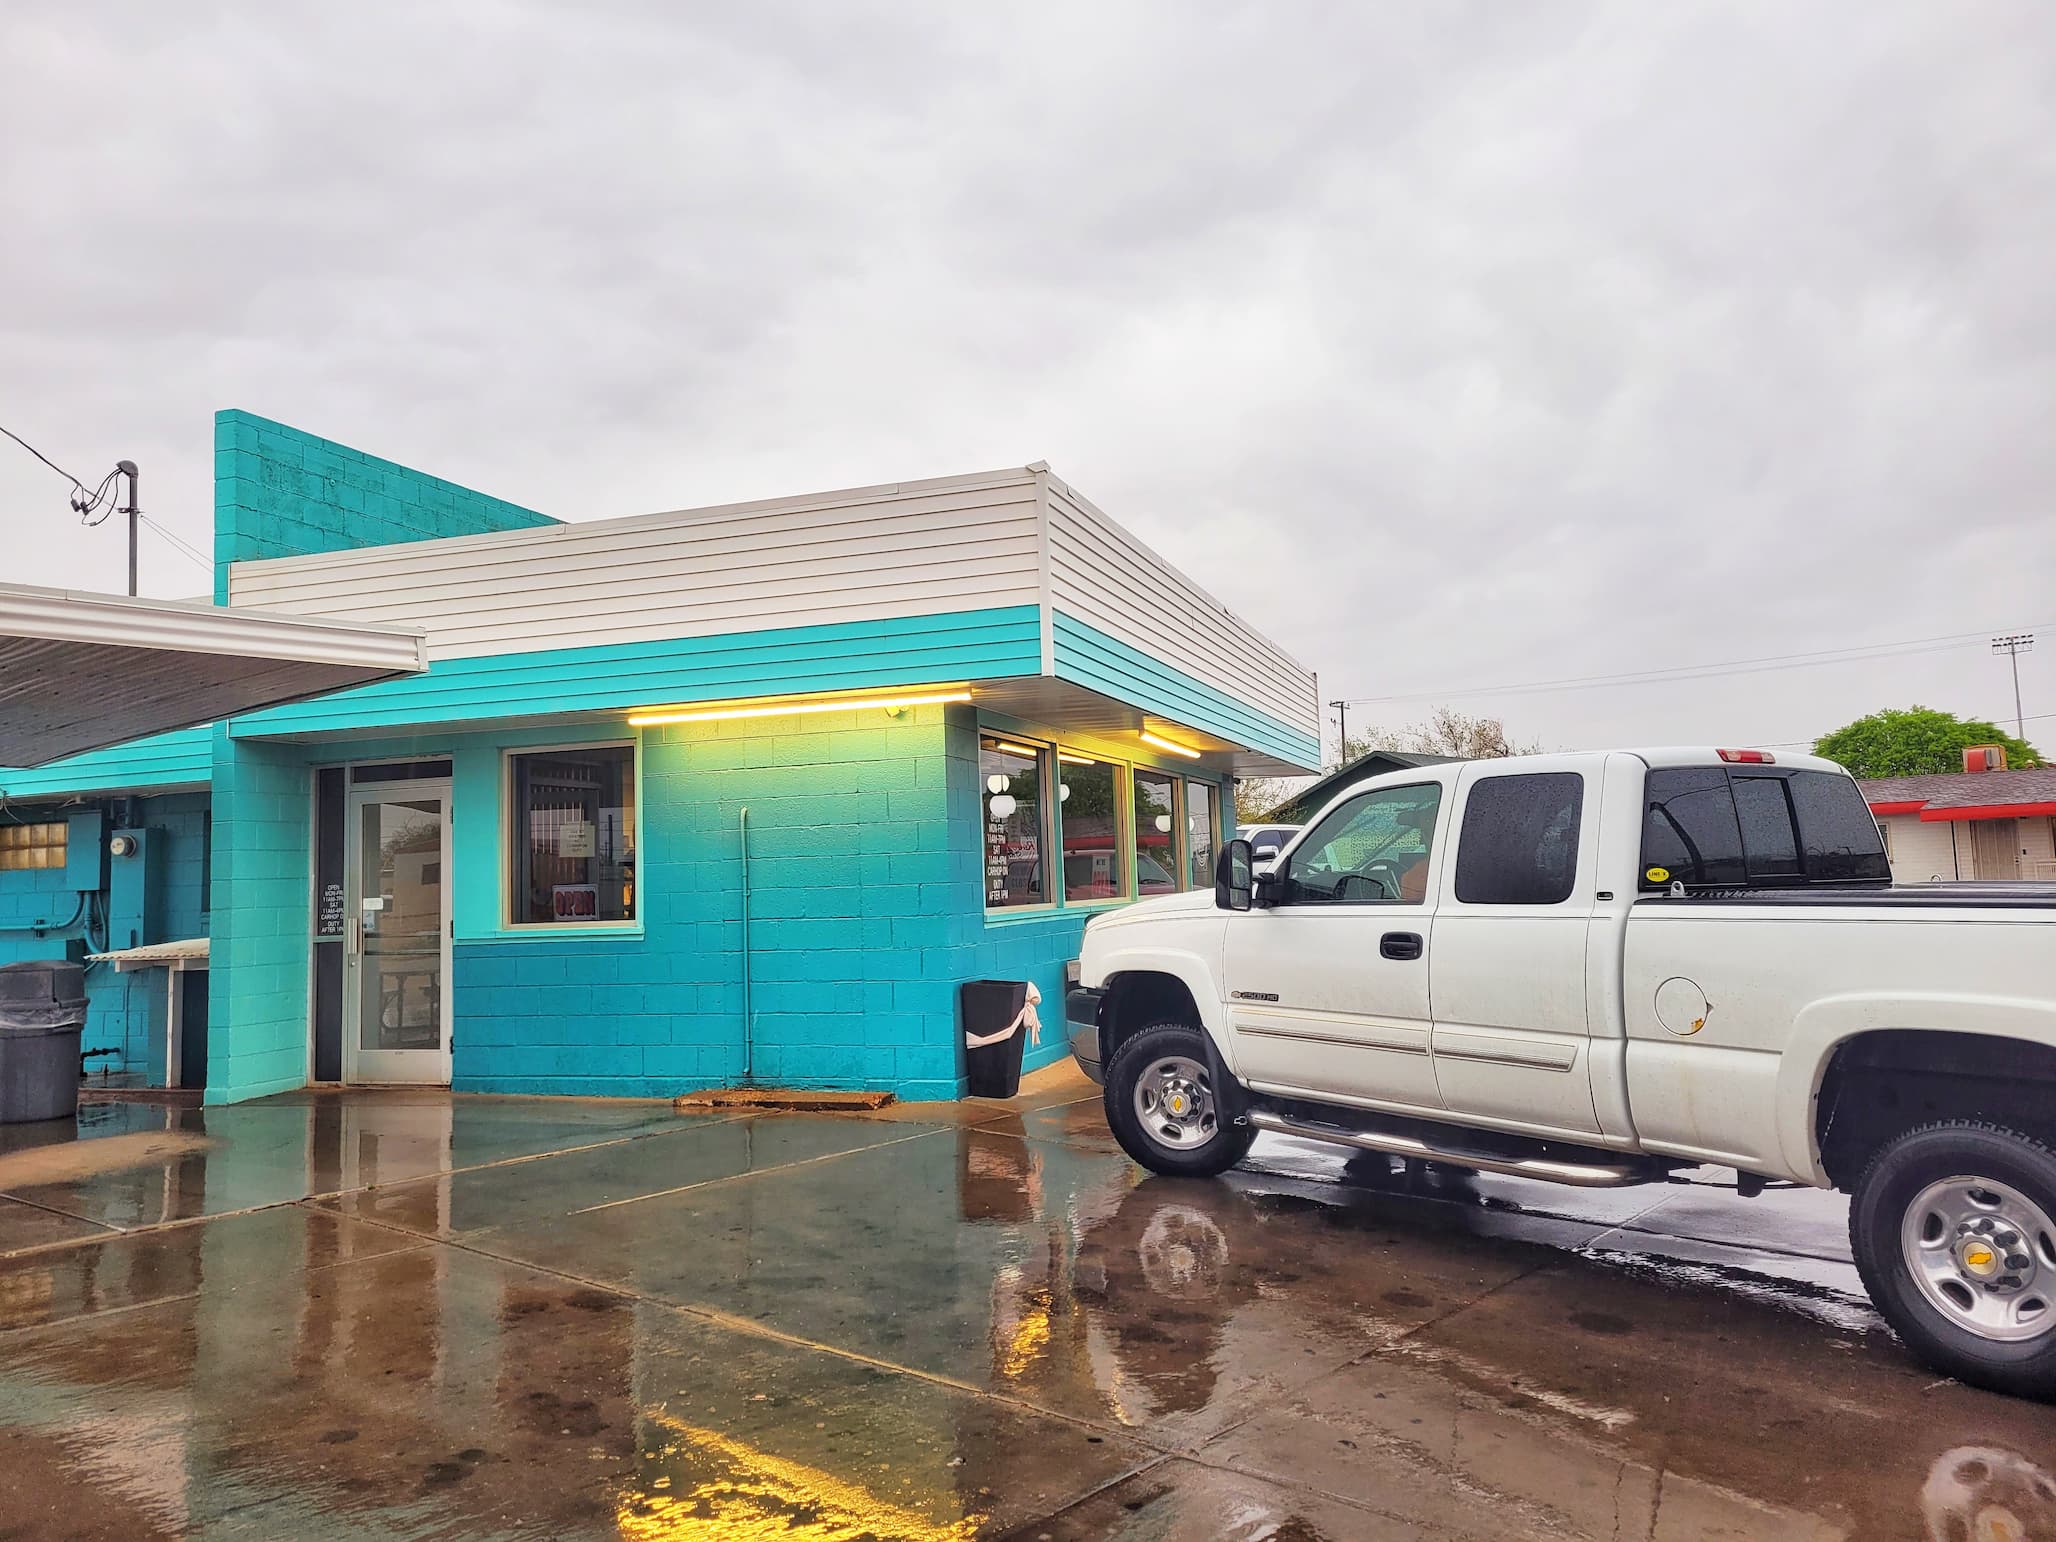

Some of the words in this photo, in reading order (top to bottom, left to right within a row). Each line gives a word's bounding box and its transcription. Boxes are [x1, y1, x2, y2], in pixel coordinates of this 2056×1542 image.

[987, 866, 1002, 876] CARHOP
[988, 890, 1000, 900] AFTER
[555, 891, 595, 916] OPEN
